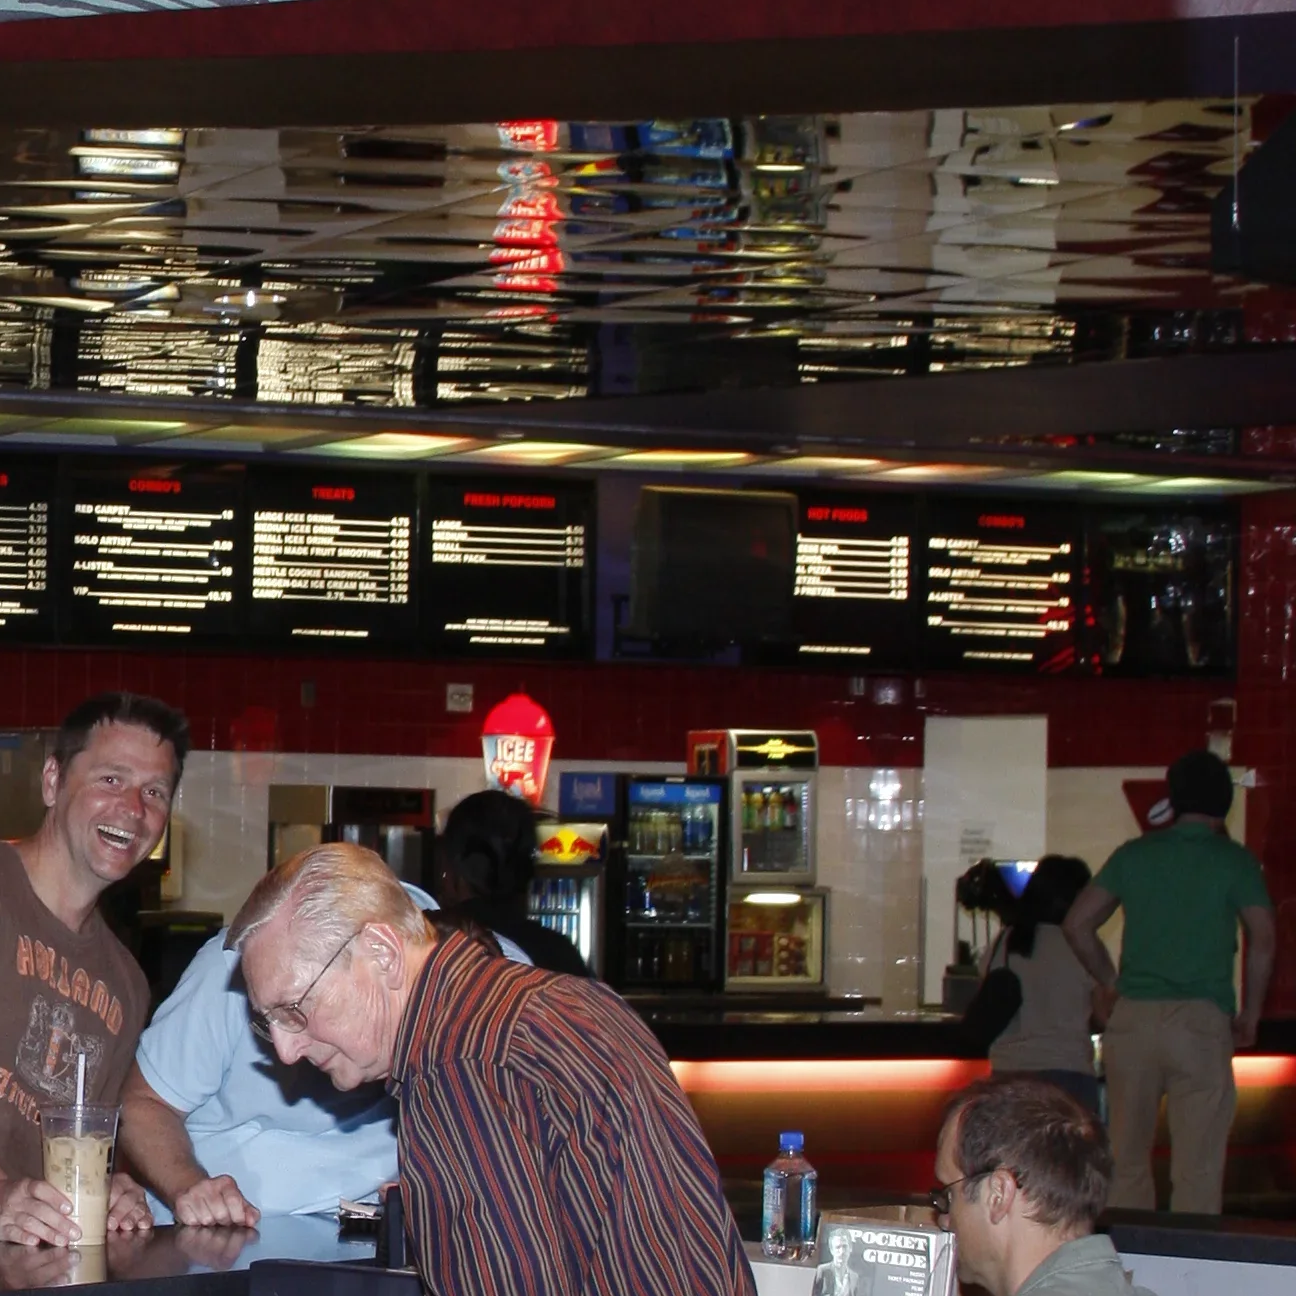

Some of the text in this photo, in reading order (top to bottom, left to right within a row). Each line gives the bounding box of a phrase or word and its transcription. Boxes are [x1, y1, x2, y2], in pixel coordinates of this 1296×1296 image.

[497, 738, 535, 762] ICEE
[16, 934, 123, 1036] HOLLAND
[848, 1228, 927, 1251] POCKET
[863, 1249, 926, 1269] GUIDE
